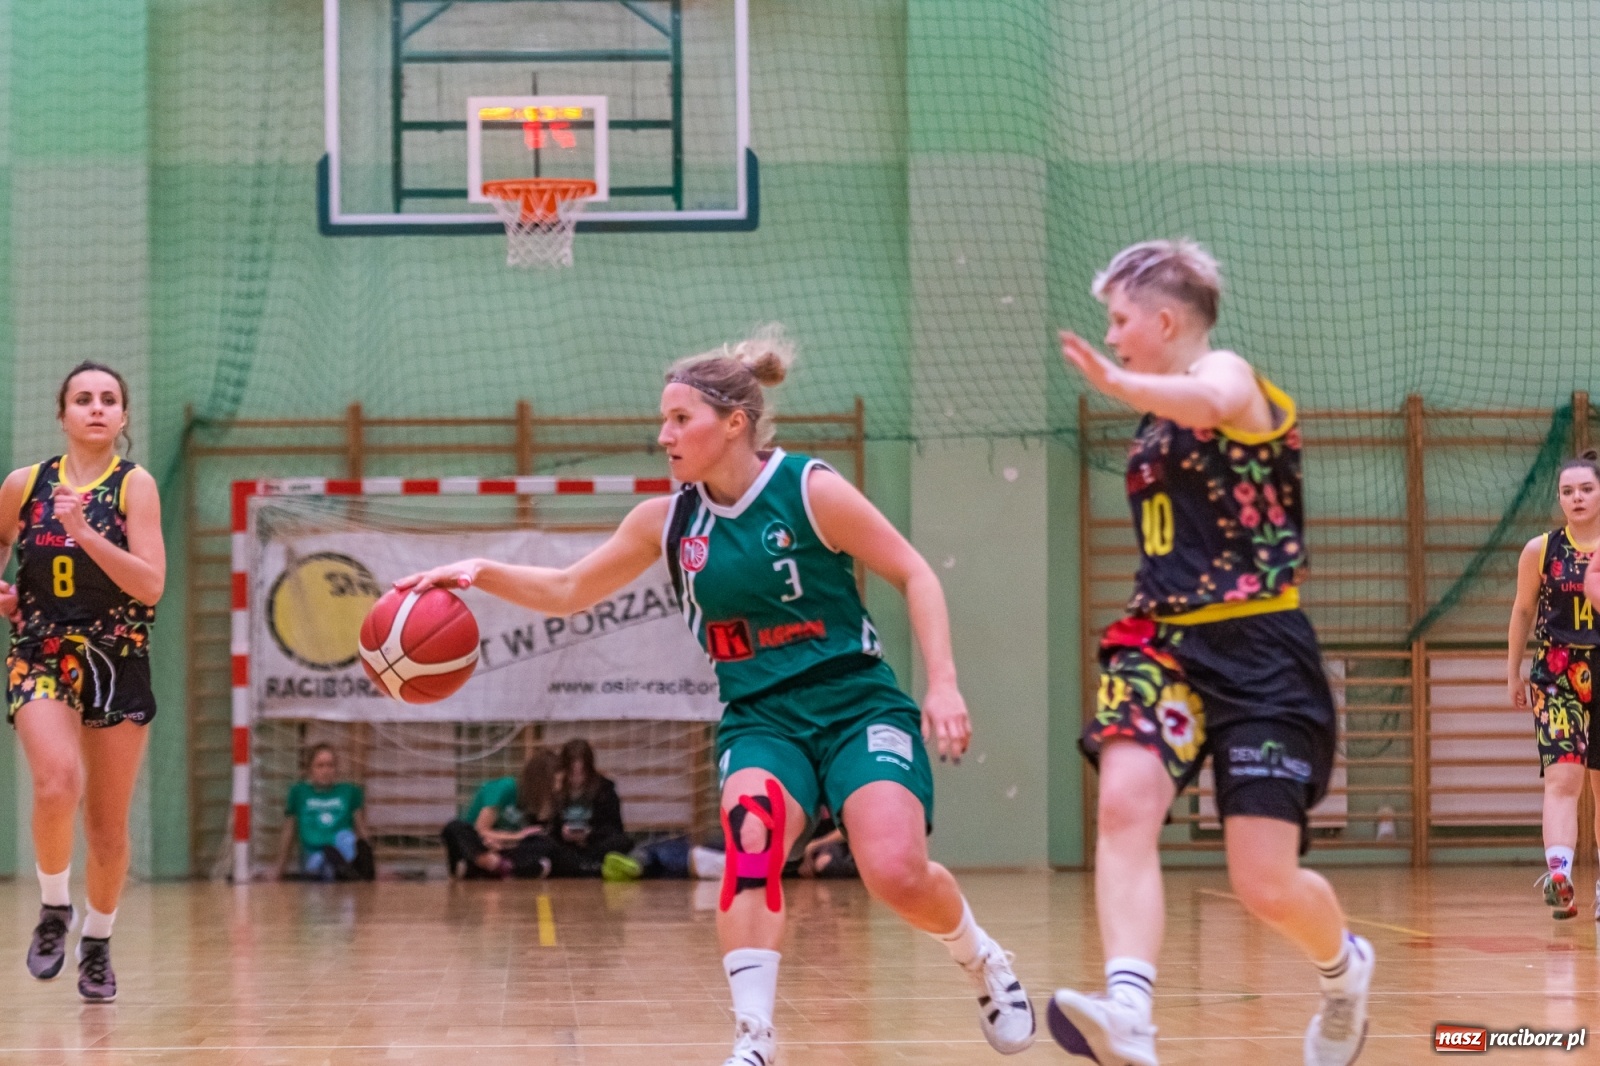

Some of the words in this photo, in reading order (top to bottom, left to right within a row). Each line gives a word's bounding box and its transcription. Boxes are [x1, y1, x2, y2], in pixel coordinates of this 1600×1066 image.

[35, 531, 79, 548] uks2
[1141, 492, 1175, 557] 10
[52, 555, 75, 598] 8
[772, 558, 804, 602] 3
[1573, 596, 1594, 630] 14
[503, 623, 534, 656] W
